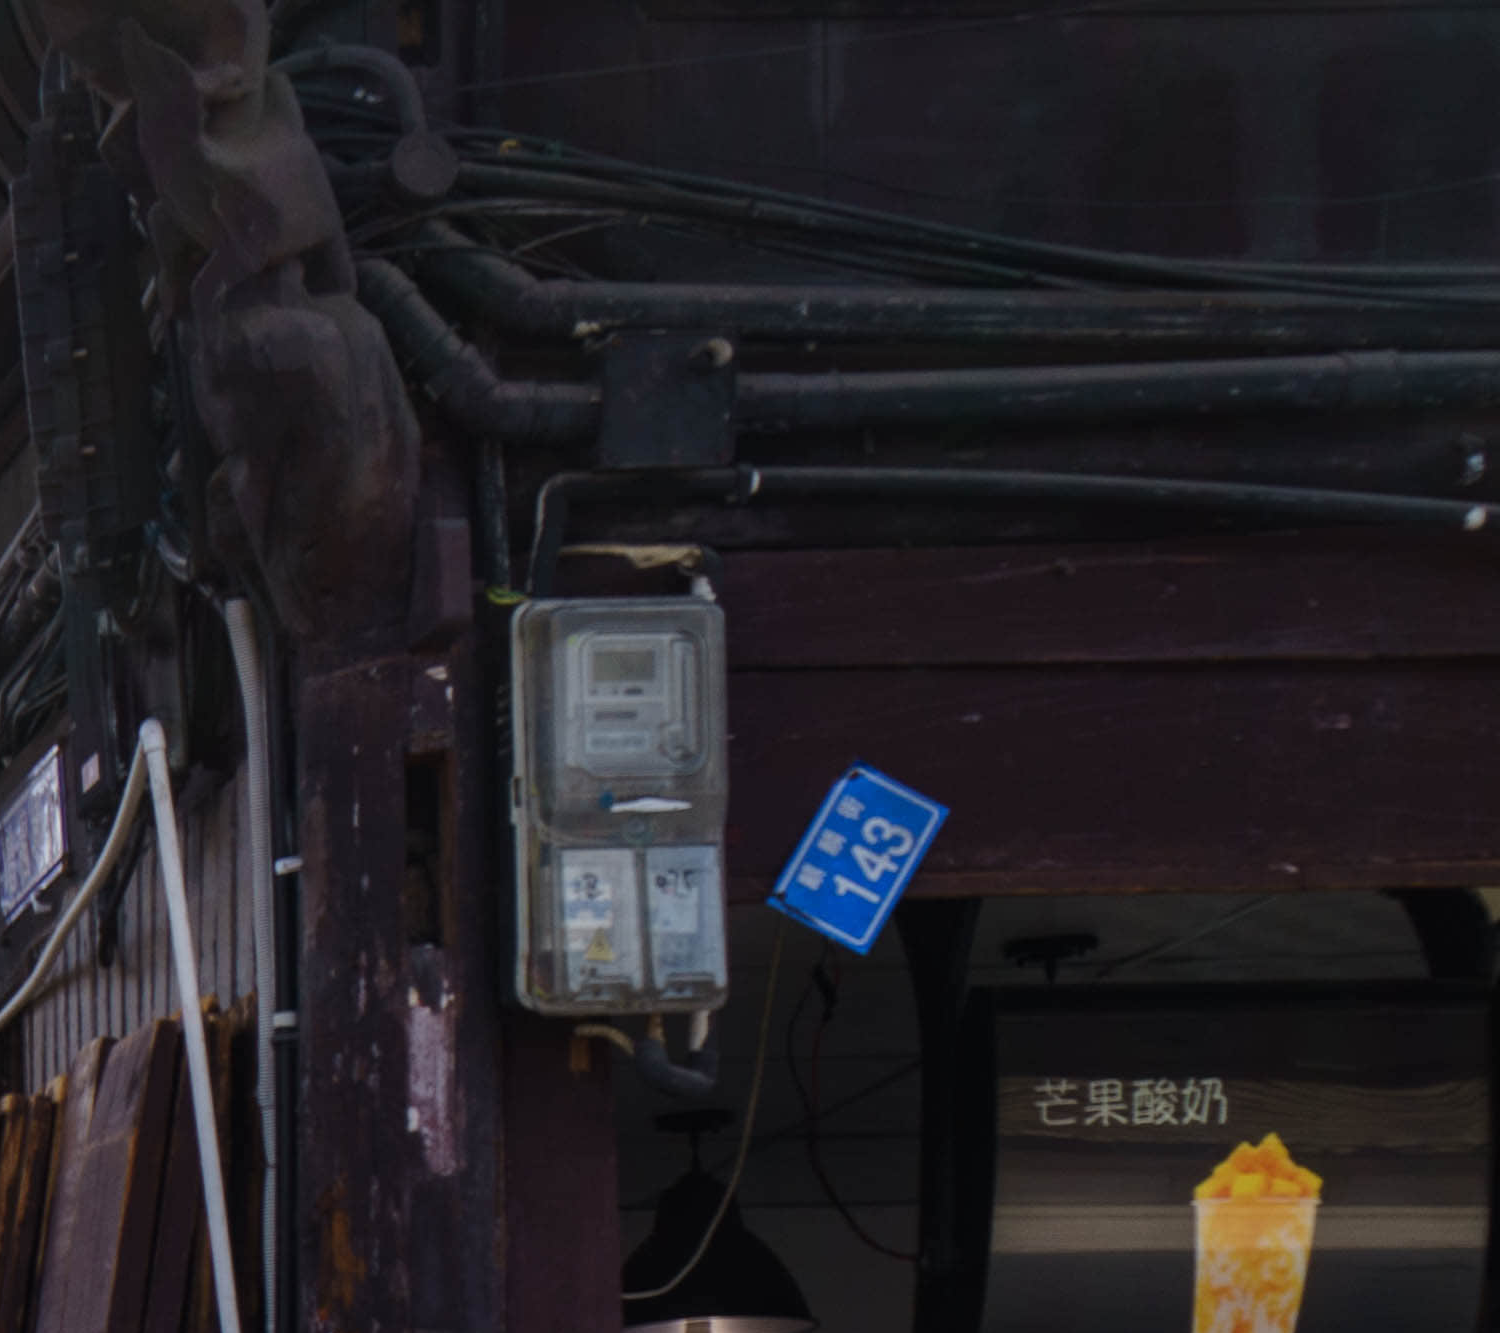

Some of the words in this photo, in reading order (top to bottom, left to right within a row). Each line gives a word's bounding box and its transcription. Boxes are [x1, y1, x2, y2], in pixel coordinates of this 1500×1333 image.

[833, 815, 914, 904] 143
[1034, 1077, 1229, 1127] 芒果酸奶
